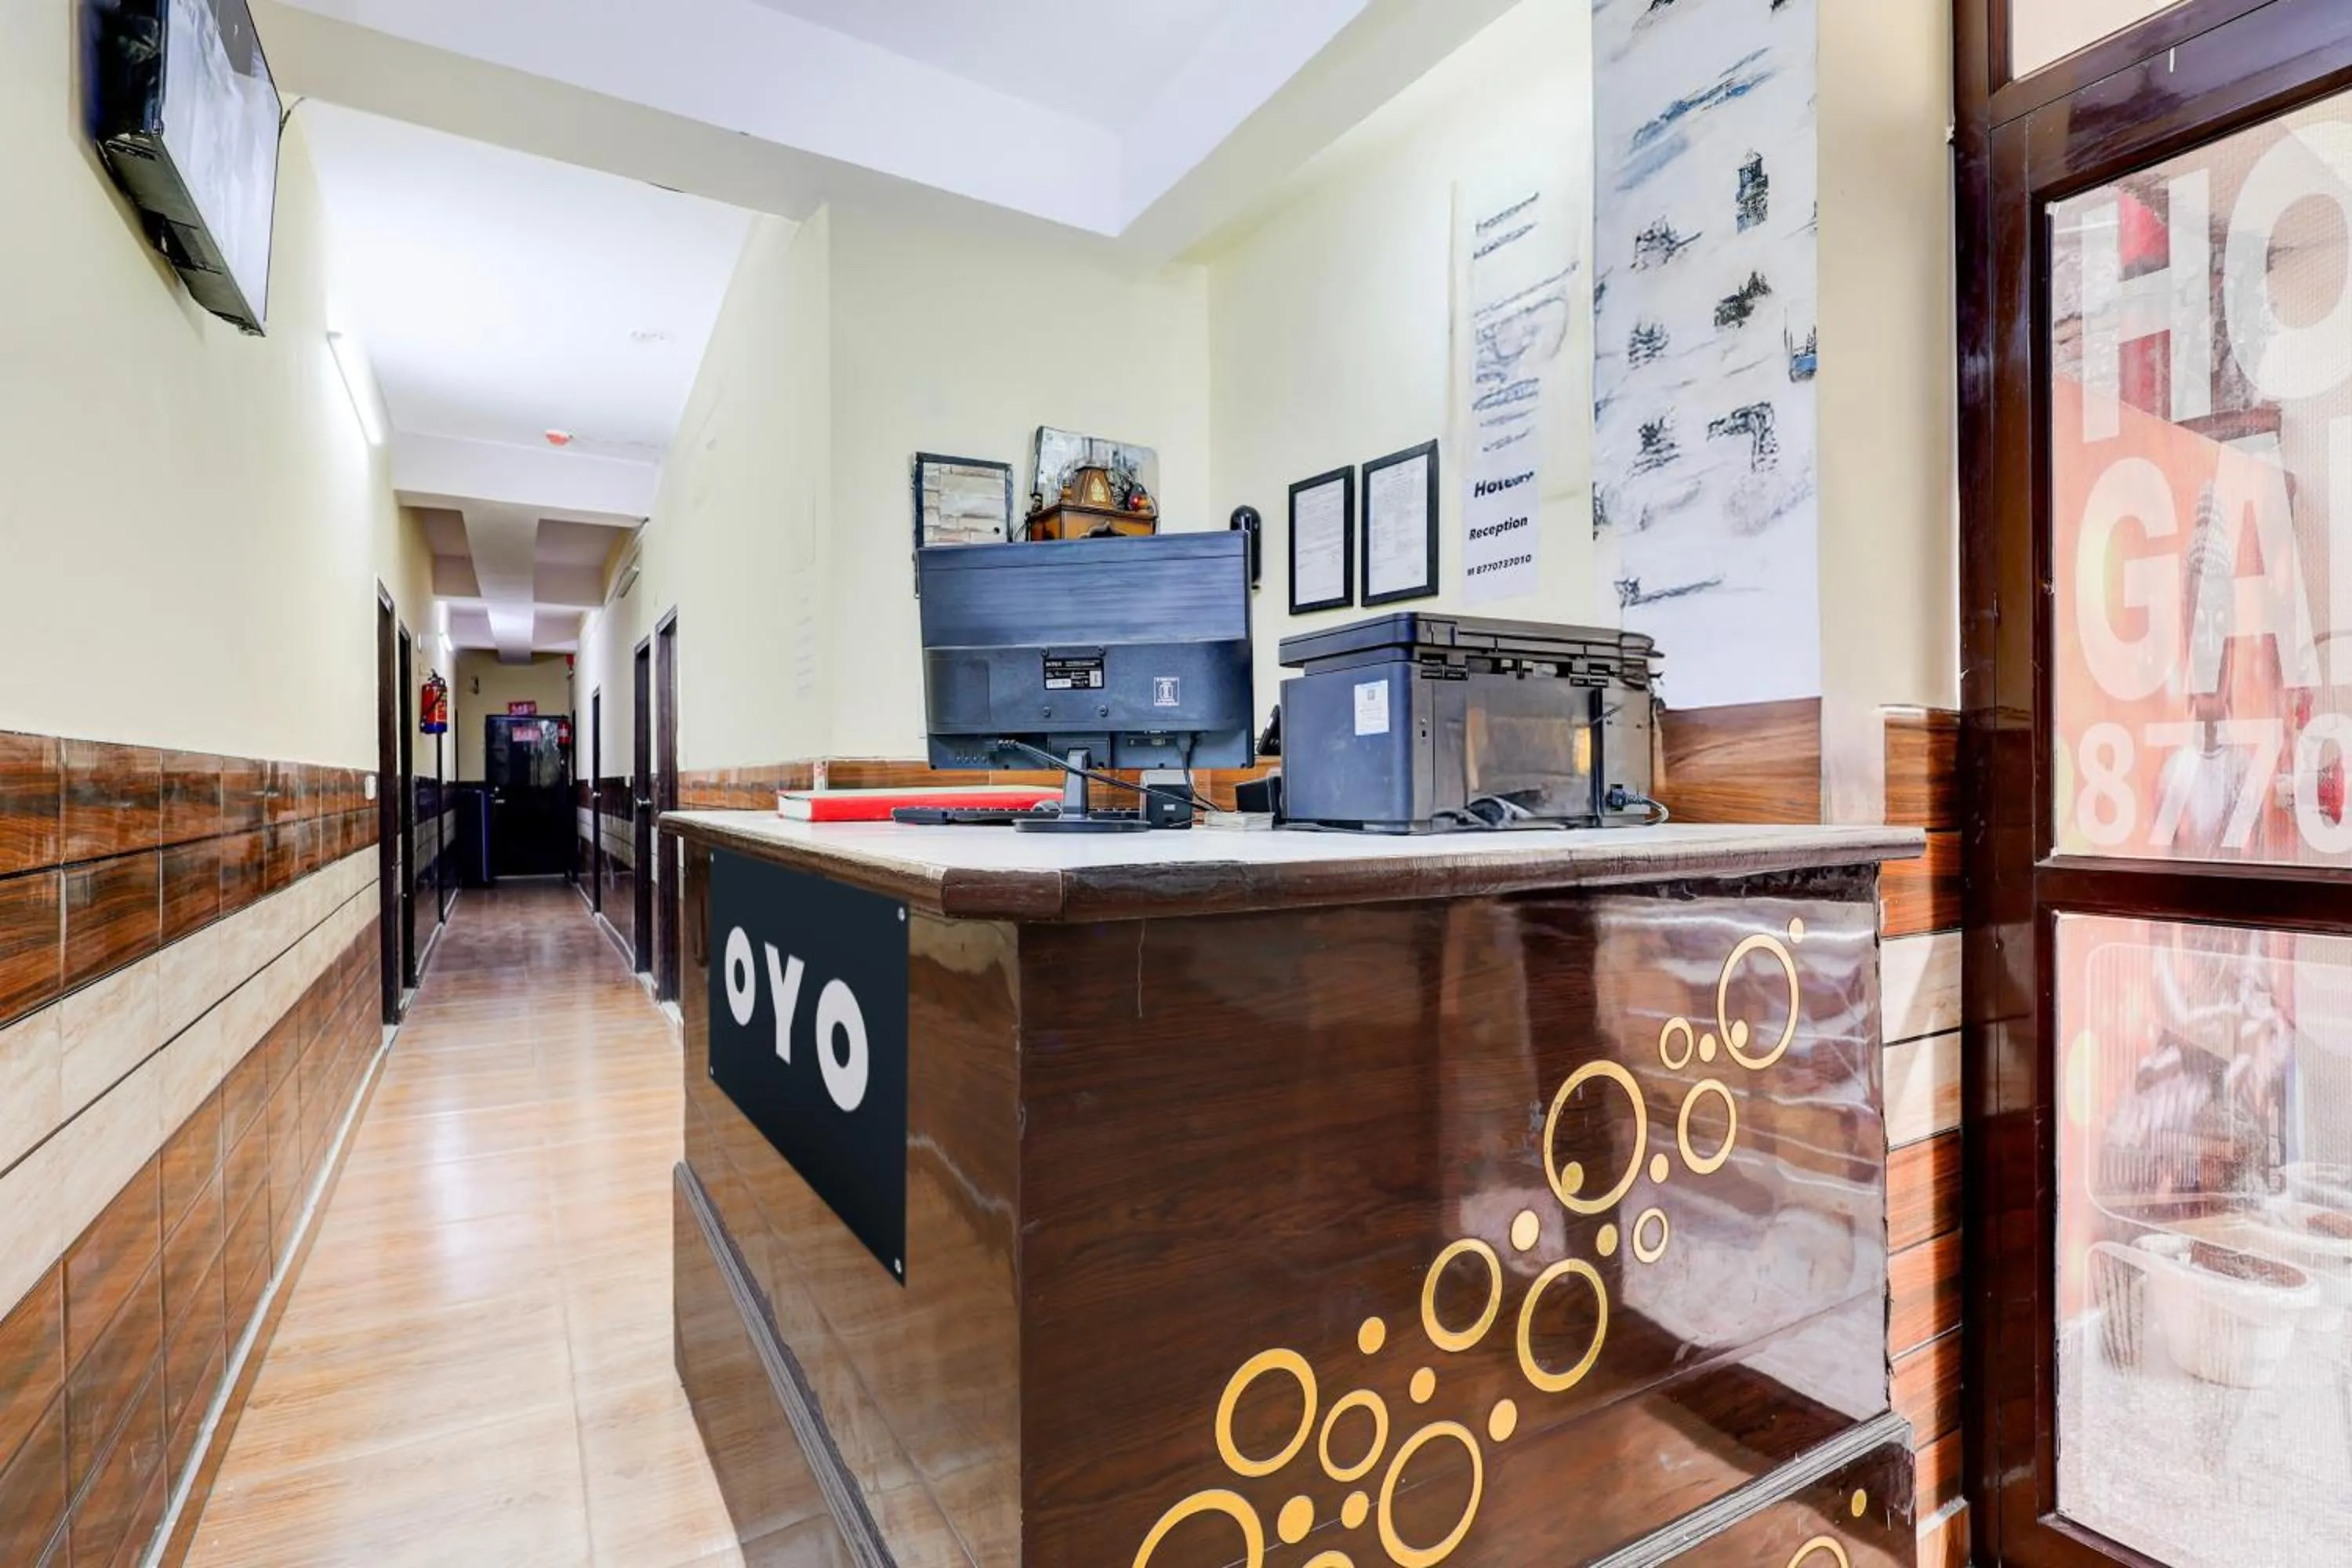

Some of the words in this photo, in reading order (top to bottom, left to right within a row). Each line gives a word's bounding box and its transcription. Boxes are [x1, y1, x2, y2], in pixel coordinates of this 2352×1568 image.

[1468, 516, 1528, 540] Reception
[2075, 416, 2352, 701] GA
[724, 926, 869, 1112] OYO
